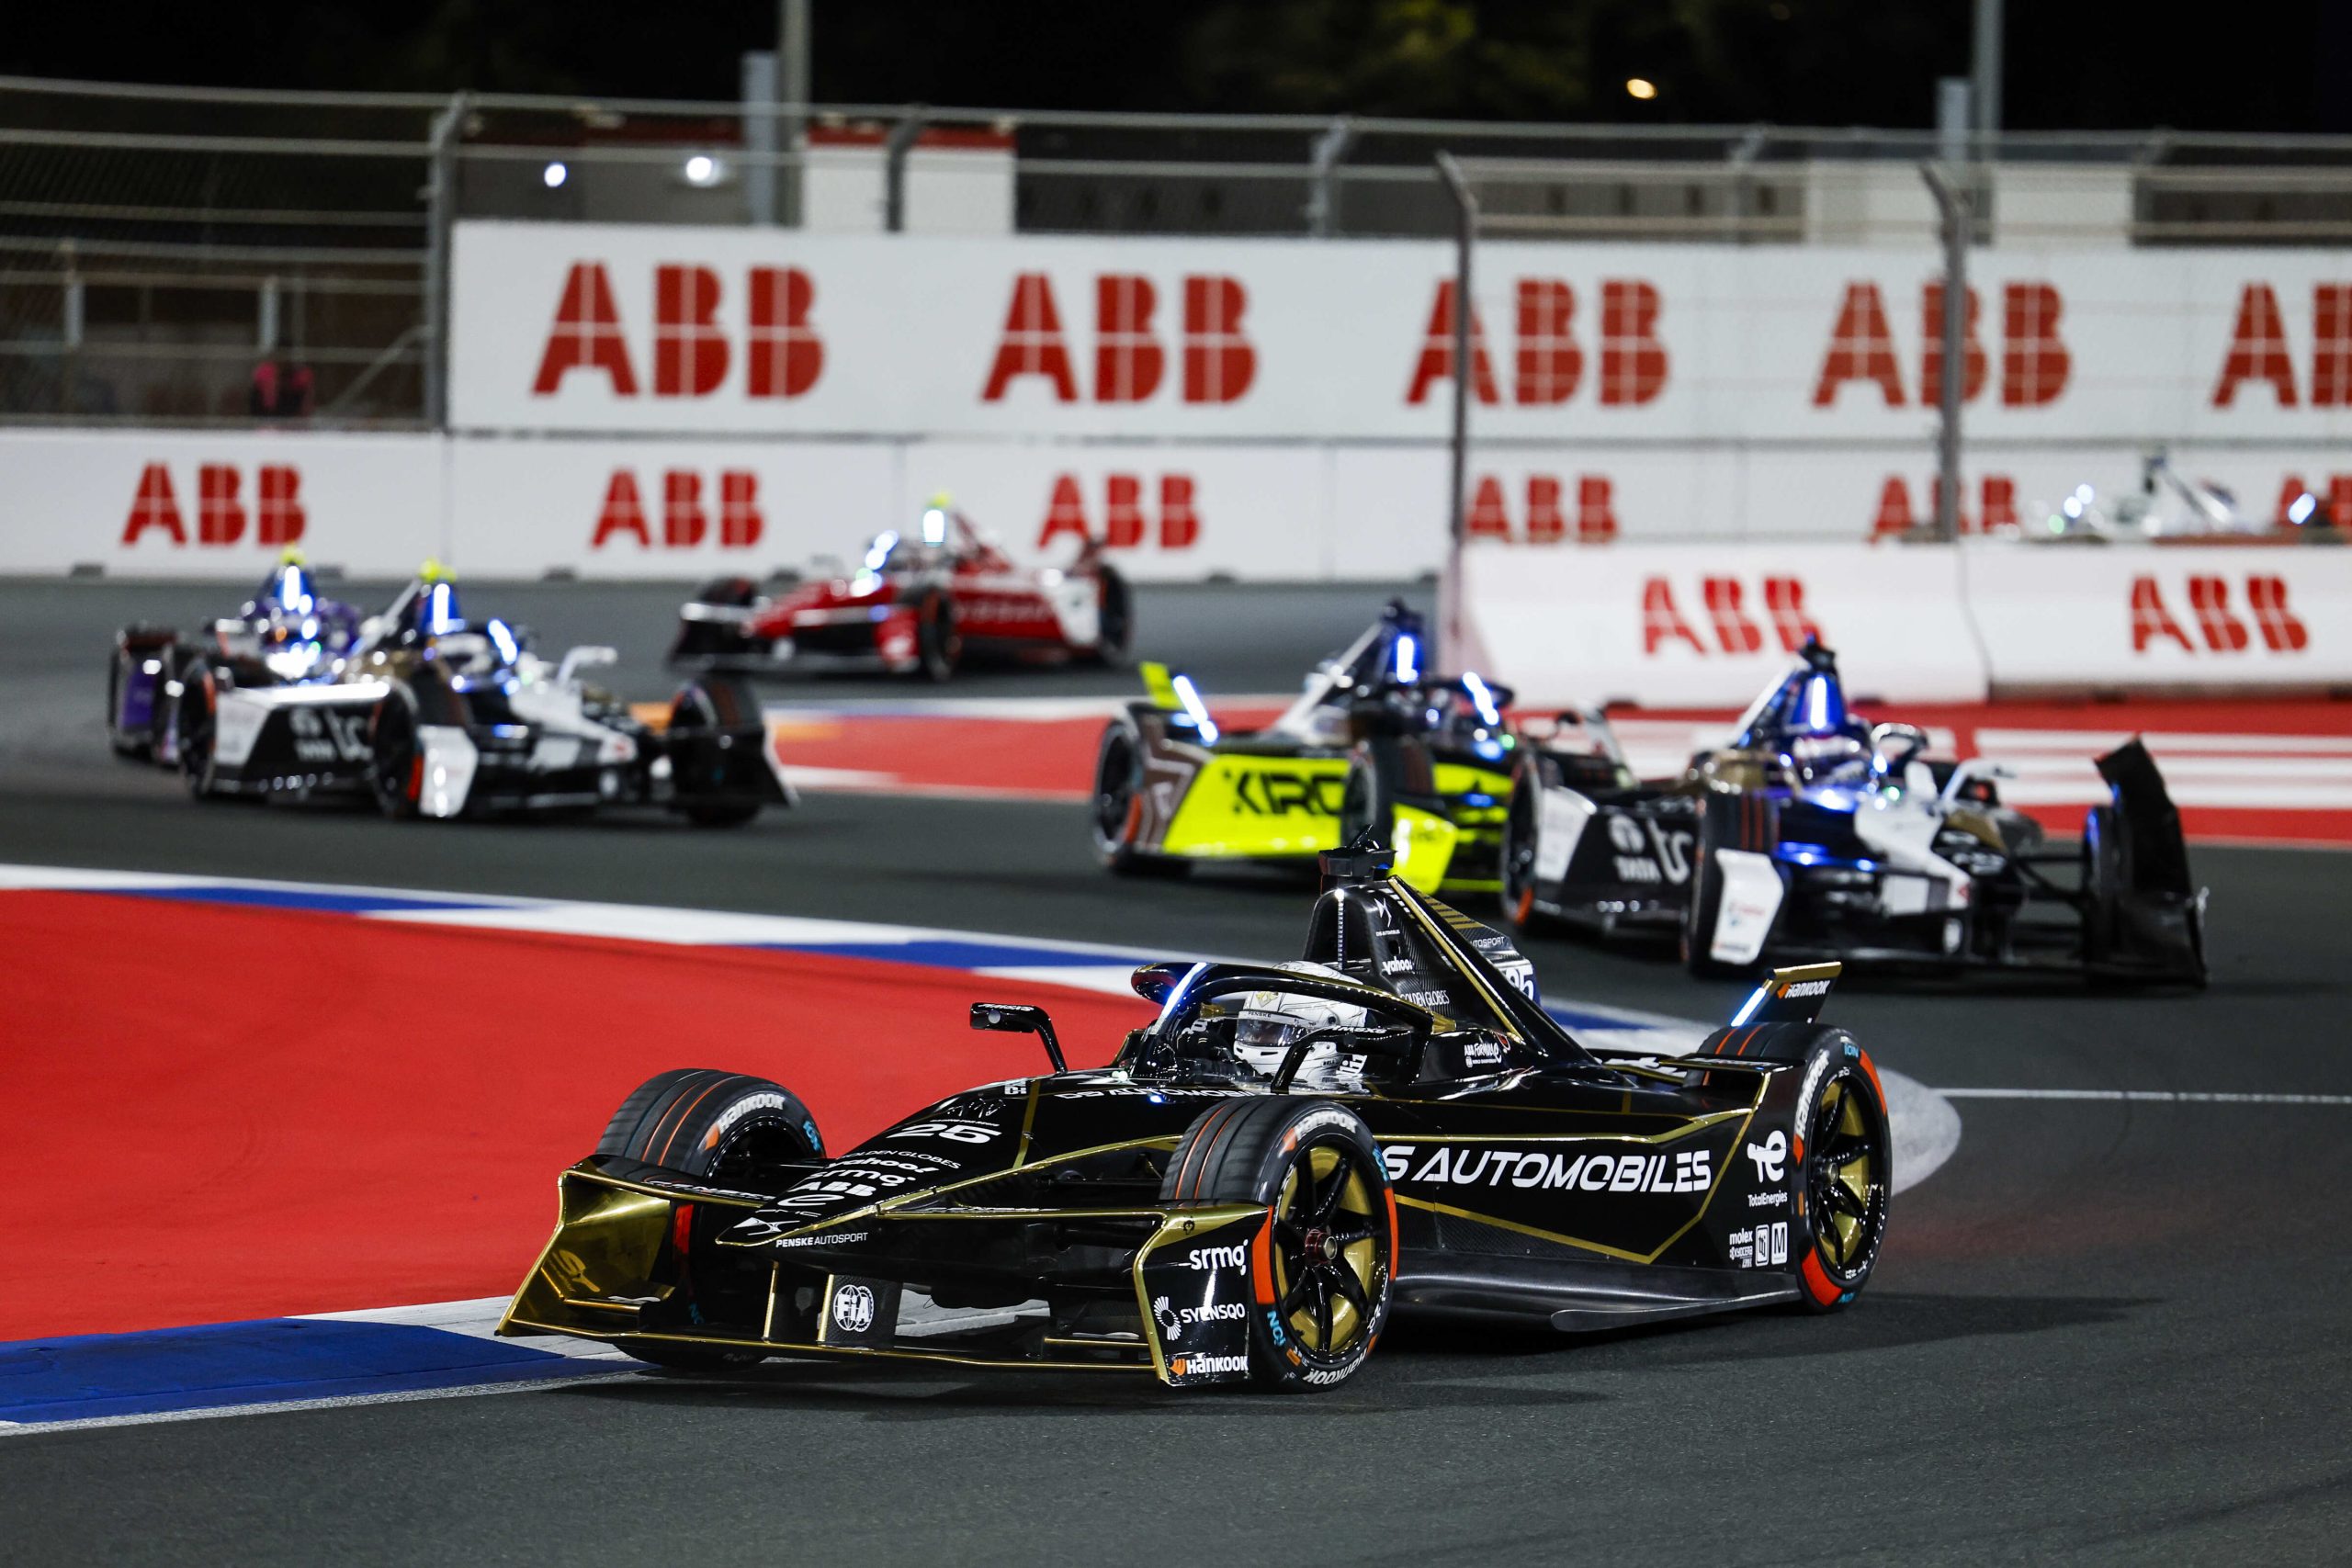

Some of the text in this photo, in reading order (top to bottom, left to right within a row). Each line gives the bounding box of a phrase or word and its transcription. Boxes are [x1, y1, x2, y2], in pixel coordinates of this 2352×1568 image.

[533, 263, 824, 399] ABB
[981, 273, 1258, 404] ABB
[1405, 279, 1668, 406] ABB
[1813, 283, 2071, 407] ABB
[2212, 285, 2352, 407] AB
[121, 463, 308, 547] ABB
[591, 468, 766, 549] ABB
[1036, 473, 1202, 550] ABB
[1466, 475, 1619, 544] ABB
[1641, 576, 1826, 655] ABB
[2130, 574, 2310, 653] ABB
[1471, 936, 1505, 948] TOSPORT
[1425, 990, 1450, 1007] GLOBES
[1108, 1088, 1256, 1098] AUTOMOBI
[887, 1122, 1002, 1144] 25
[898, 1150, 961, 1169] GLOBES
[787, 1181, 876, 1196] ABB
[825, 1156, 940, 1173] yahoo!
[1382, 1145, 1417, 1181] S
[1411, 1147, 1712, 1193] AUTOMOBILES
[1747, 1190, 1788, 1207] TotalEnergies
[775, 1232, 868, 1248] PENSKE AUTOSPORT
[1729, 1227, 1753, 1246] molex
